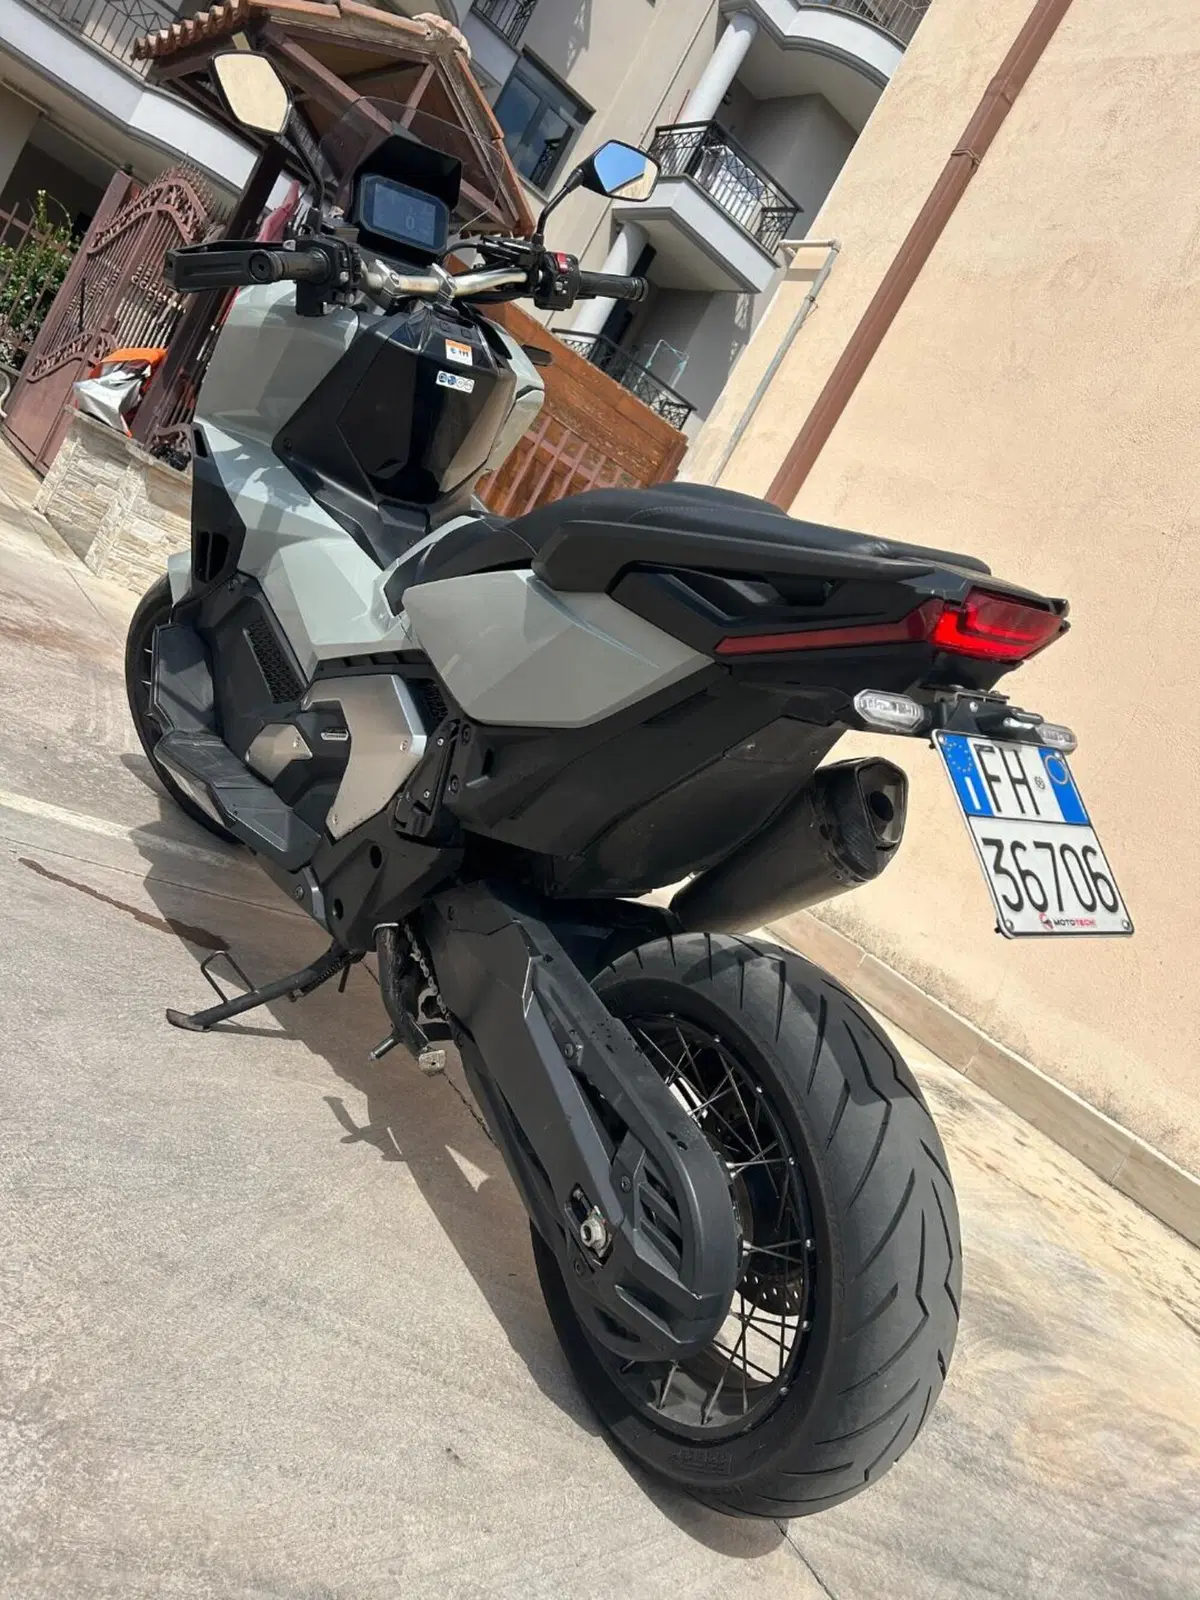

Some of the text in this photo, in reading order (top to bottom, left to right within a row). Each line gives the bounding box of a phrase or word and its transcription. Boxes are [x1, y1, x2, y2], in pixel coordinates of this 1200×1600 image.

[973, 744, 1040, 816] FH
[981, 837, 1119, 913] 36706
[1053, 918, 1096, 927] MOTOTECH
